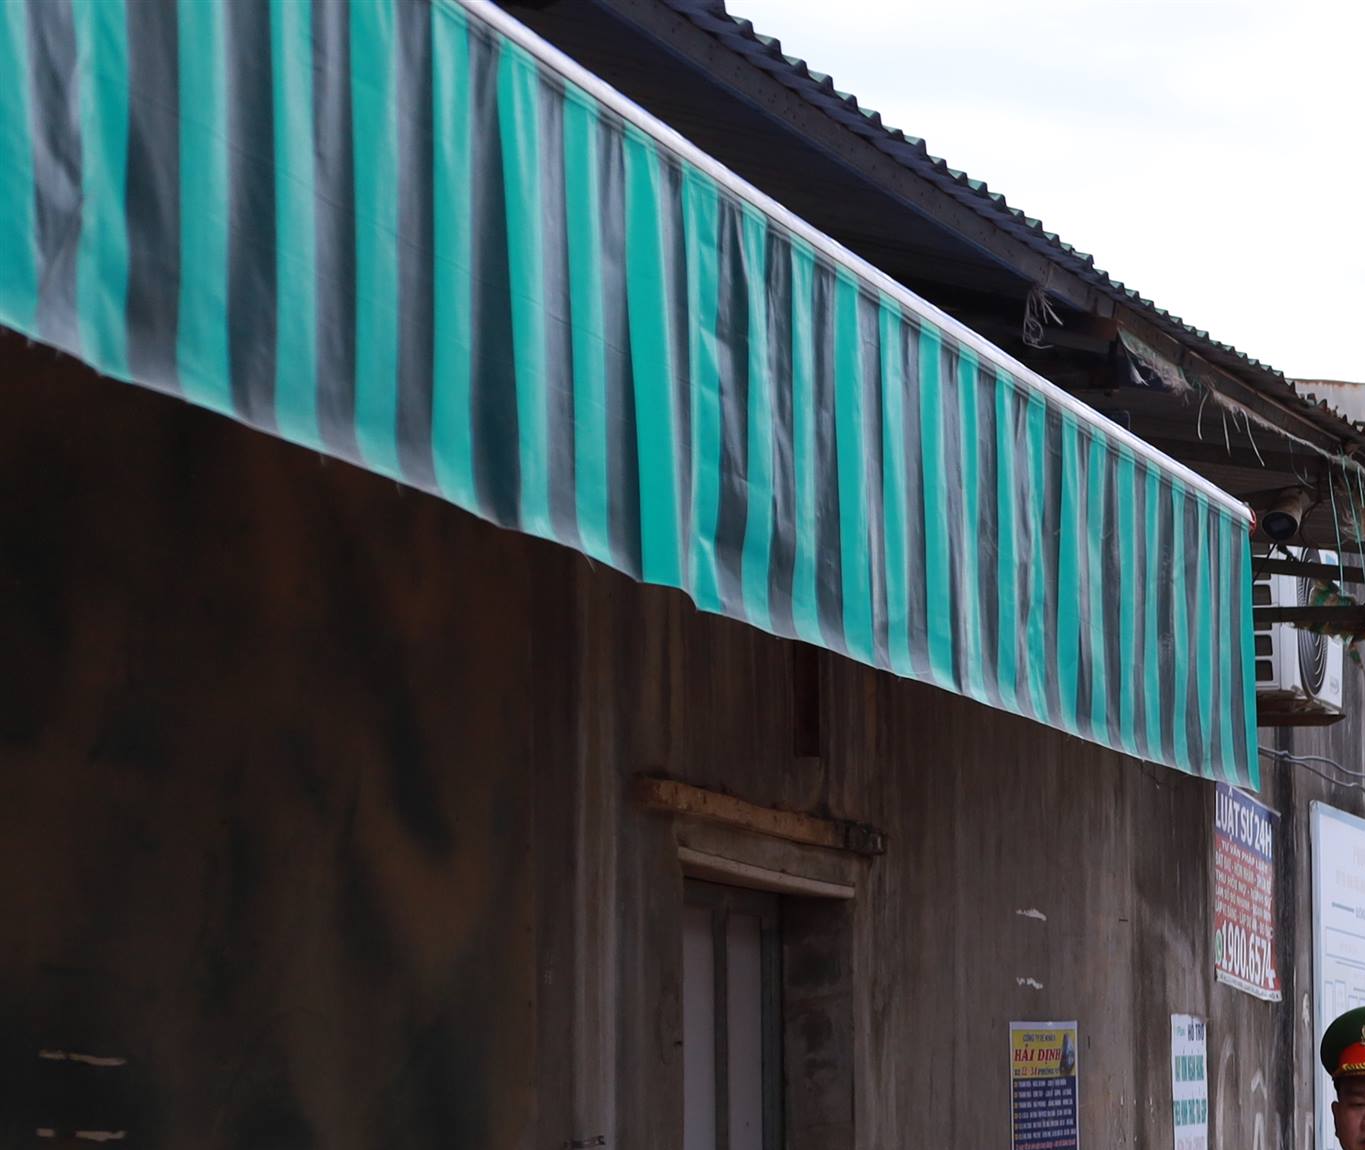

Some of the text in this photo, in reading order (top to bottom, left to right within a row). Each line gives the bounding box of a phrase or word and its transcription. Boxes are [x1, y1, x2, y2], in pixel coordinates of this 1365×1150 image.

[1215, 786, 1272, 859] LUẬT SƯ 24H
[1014, 1043, 1034, 1062] HẢI
